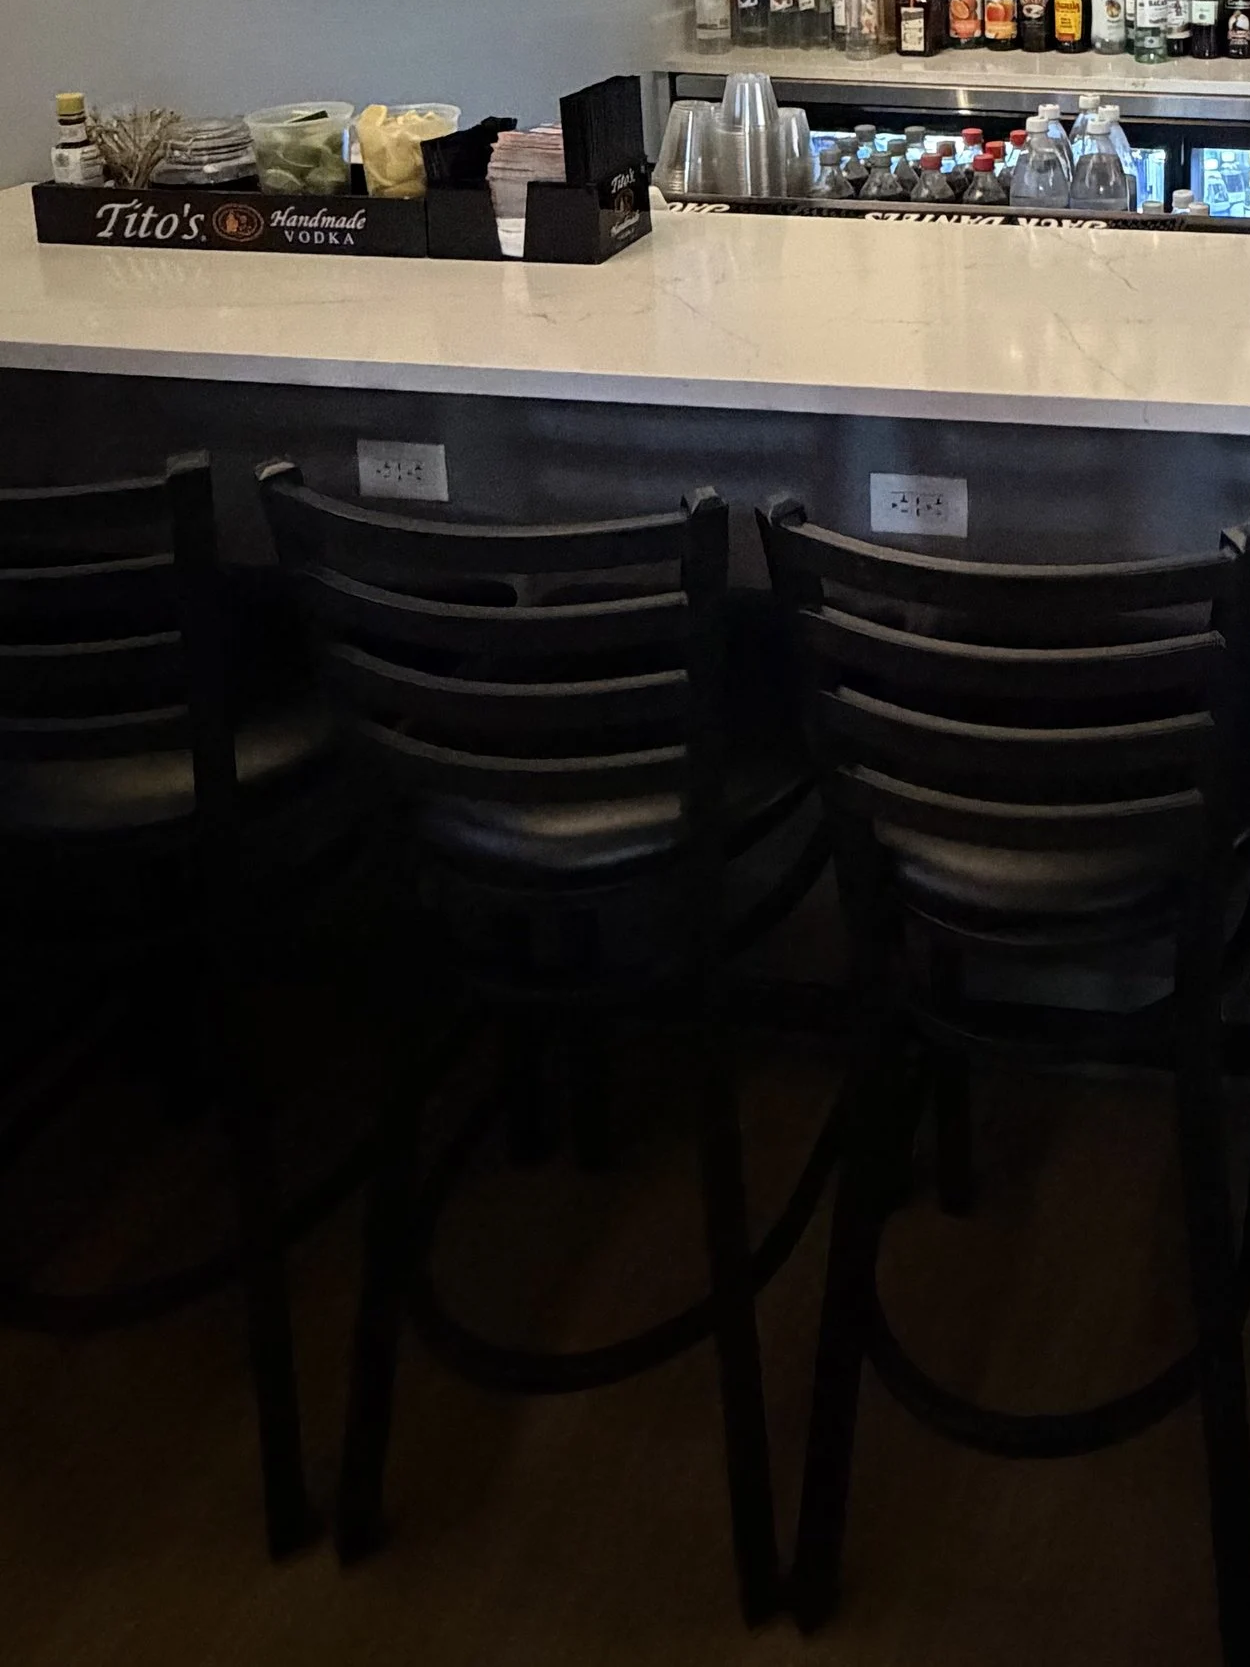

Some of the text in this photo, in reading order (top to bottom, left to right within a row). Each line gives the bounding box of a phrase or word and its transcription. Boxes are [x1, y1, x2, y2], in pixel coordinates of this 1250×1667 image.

[96, 198, 205, 241] Tito's
[270, 205, 367, 230] Handmade
[284, 229, 354, 245] VODKA
